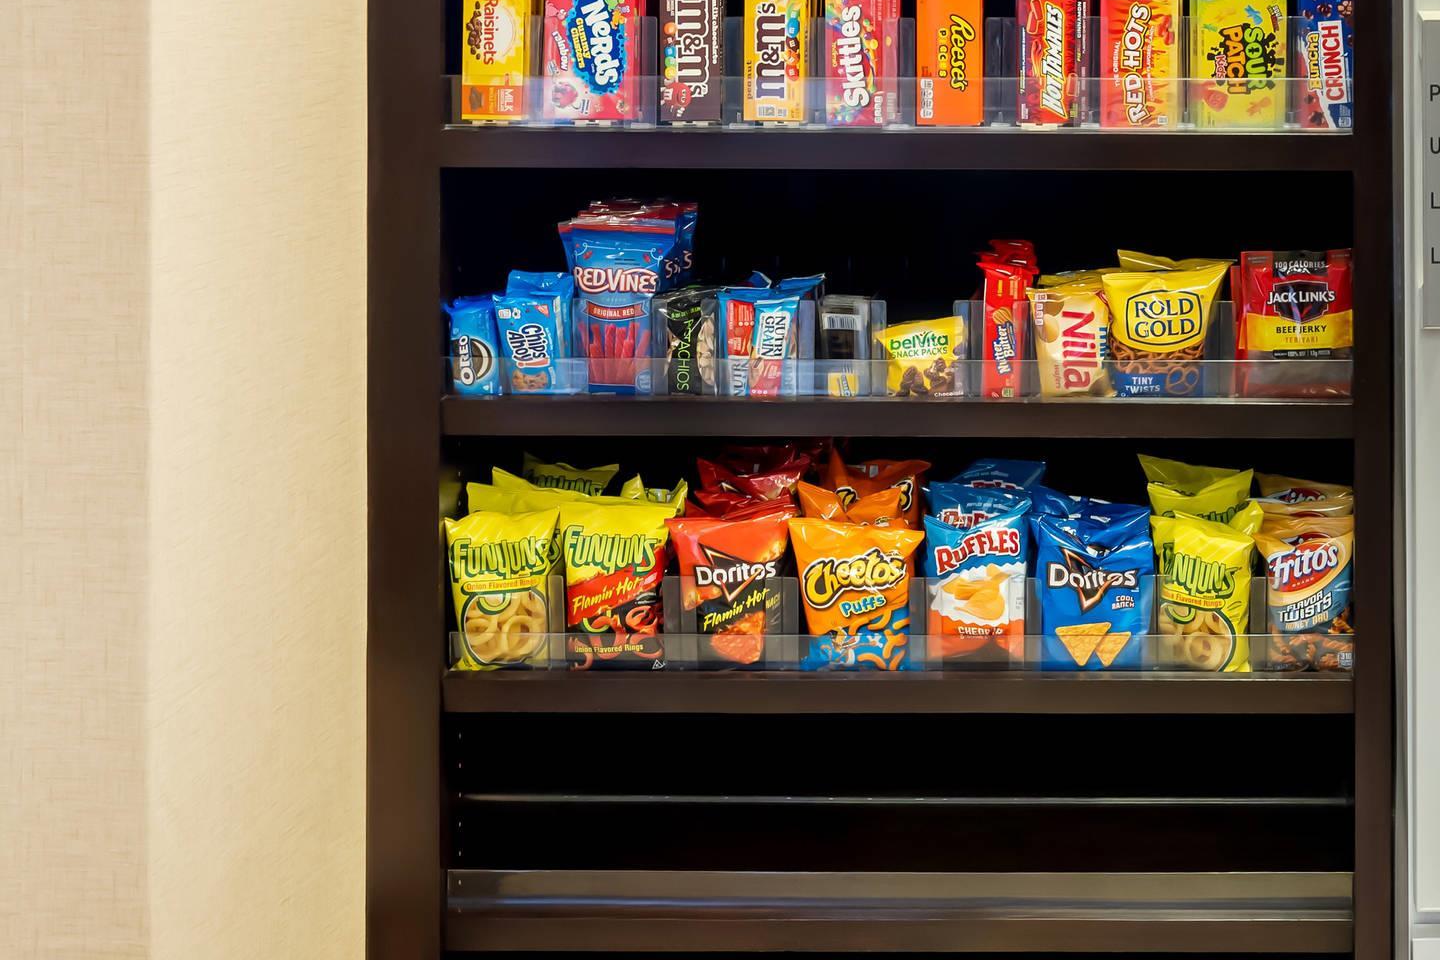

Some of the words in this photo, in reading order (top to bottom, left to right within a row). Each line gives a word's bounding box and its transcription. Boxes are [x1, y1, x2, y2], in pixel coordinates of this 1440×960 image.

[551, 30, 569, 71] rainbow
[1041, 3, 1064, 80] TAMALES
[1122, 3, 1150, 70] HOTS
[950, 14, 976, 92] Reese's
[1112, 40, 1121, 72] ORIGINAL
[1221, 24, 1247, 94] PATCH
[1243, 27, 1267, 90] SOUR
[1321, 24, 1345, 101] CRUNCH
[503, 88, 514, 112] MILK
[1041, 74, 1065, 117] HOT
[1123, 72, 1149, 125] RED
[593, 307, 621, 317] ORIGINAL
[622, 307, 635, 316] RED
[1135, 298, 1194, 319] ROLD
[1267, 292, 1298, 305] JACK
[520, 324, 547, 360] Chips
[761, 316, 775, 357] GRAIN
[775, 315, 787, 357] NUTRI
[889, 330, 949, 351] belVita
[1000, 325, 1015, 358] Butter
[1135, 318, 1195, 338] GOLD
[1276, 325, 1297, 334] BEEF
[1298, 325, 1327, 333] JERKY
[459, 336, 476, 385] OREO
[891, 349, 920, 359] SNACK
[921, 347, 949, 357] PACKS
[994, 339, 1012, 374] Nutter
[1061, 310, 1098, 389] Nilla
[1125, 384, 1160, 395] TWISTS
[1131, 376, 1154, 385] TINY
[695, 560, 777, 586] Doritos
[804, 551, 907, 606] Cheetos
[1050, 563, 1138, 589] Doritos
[1268, 543, 1340, 591] Fritos
[466, 582, 488, 591] Onion
[488, 581, 519, 589] Flavored
[519, 579, 539, 587] Rings
[616, 579, 643, 595] Hot
[1175, 594, 1202, 605] Flavored
[1203, 598, 1223, 607] Rings
[703, 600, 745, 632] Flamin'
[746, 587, 770, 610] Hot
[841, 596, 885, 617] Puffs
[1111, 601, 1135, 609] RANCH
[1279, 592, 1332, 623] TWISTS
[1286, 591, 1323, 612] FLAVOR
[594, 645, 623, 653] Flavored
[624, 643, 644, 652] Rings
